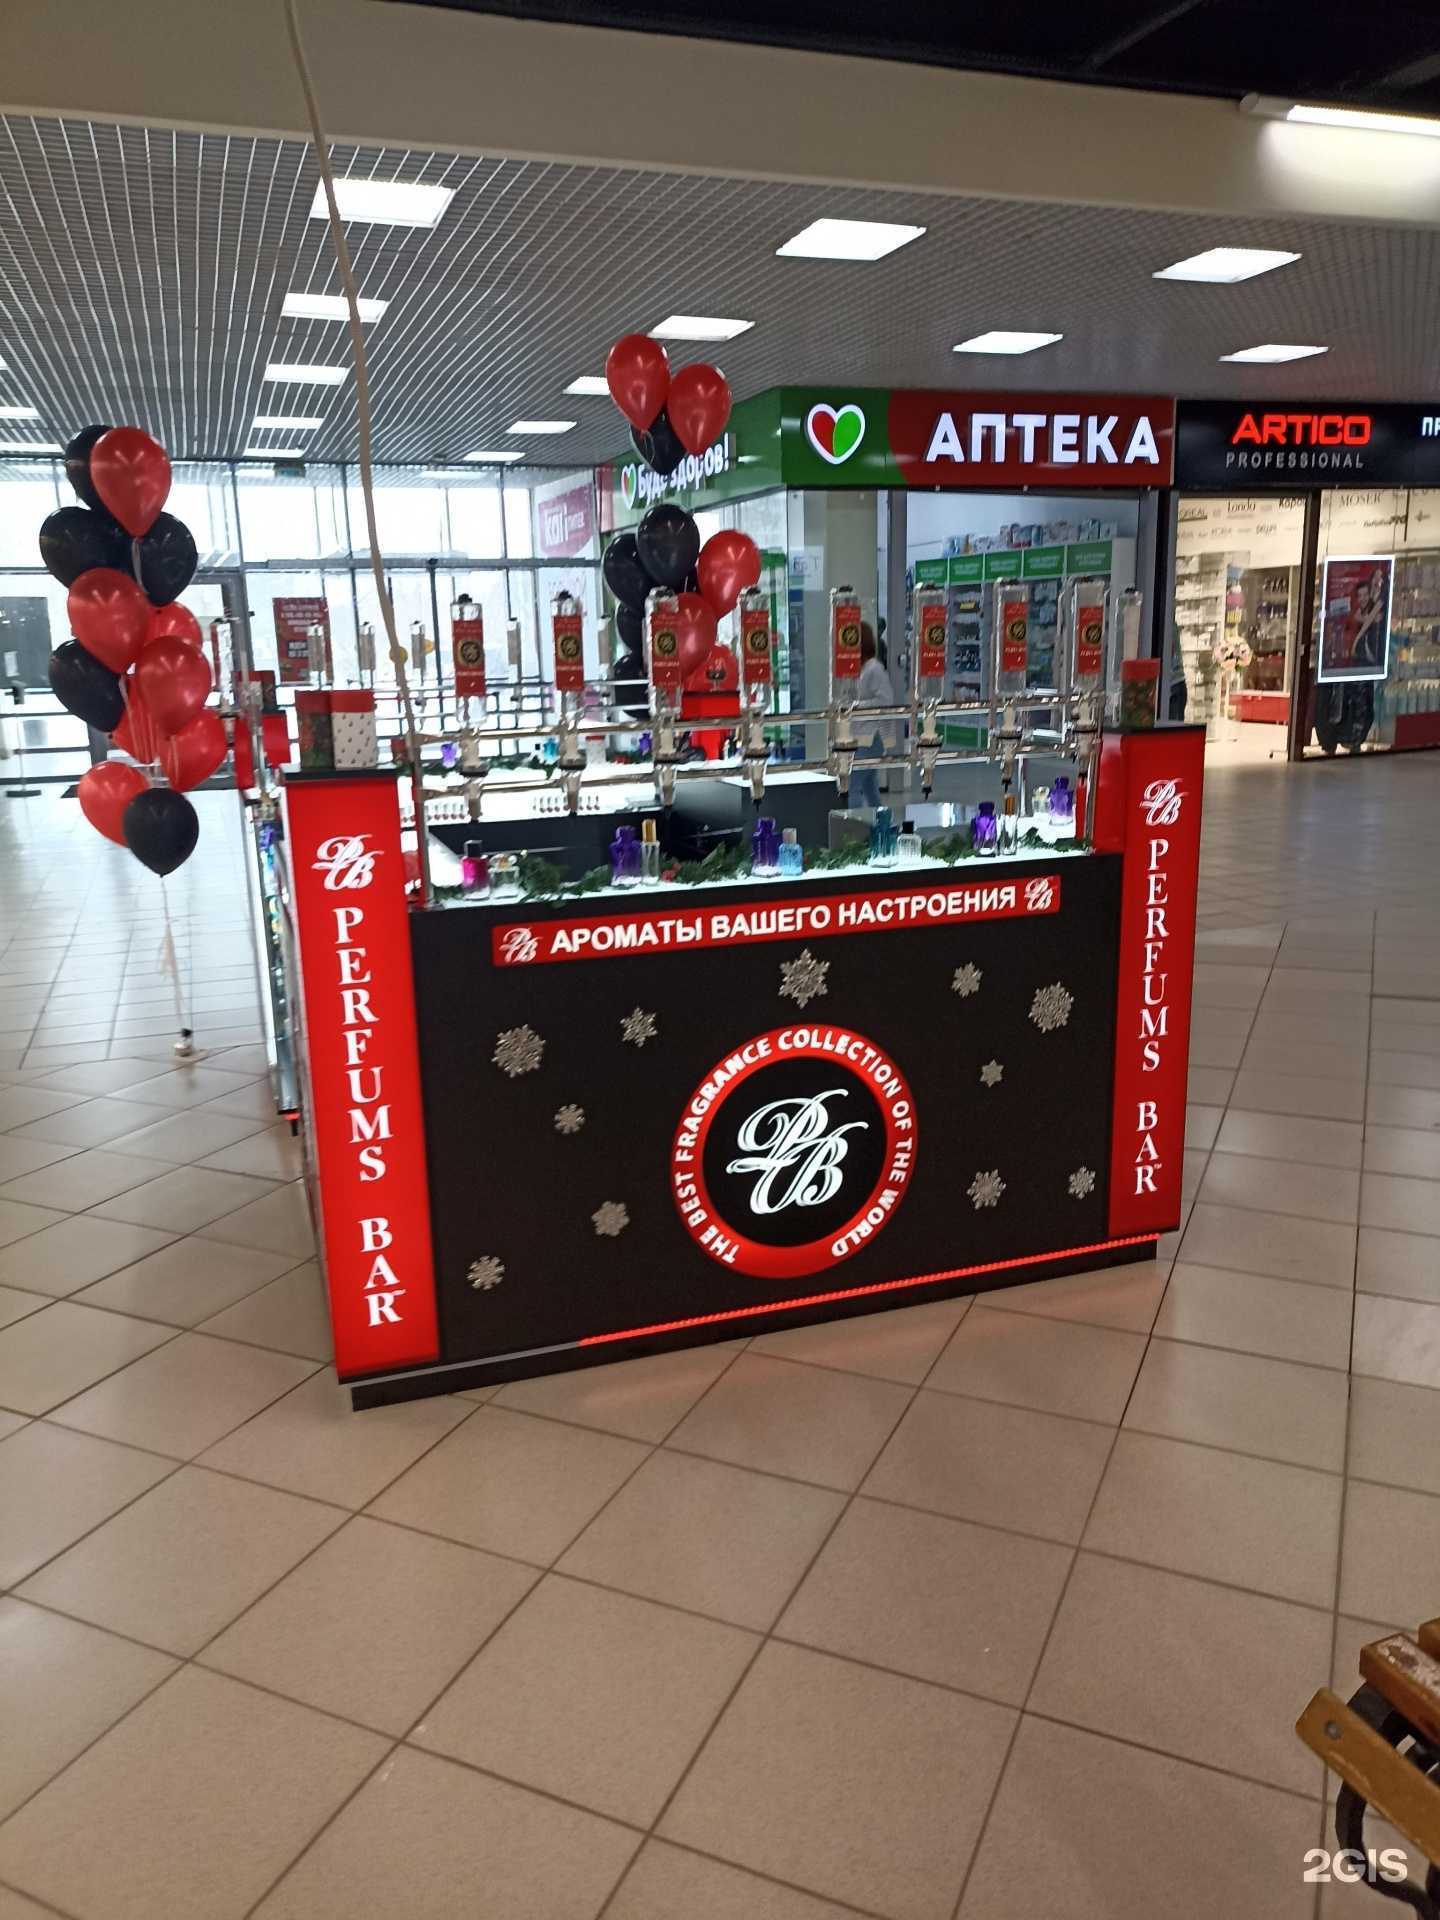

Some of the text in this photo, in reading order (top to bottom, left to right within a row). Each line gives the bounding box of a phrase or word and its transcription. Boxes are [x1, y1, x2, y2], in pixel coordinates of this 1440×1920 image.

[926, 412, 1160, 465] АПТЕКА
[1225, 452, 1365, 469] PROFESSIONAL
[1232, 413, 1372, 445] ARTICO
[550, 886, 1016, 955] АРОМАТЫ ВАШЕГО НАСТРОЕНИЯ
[1138, 838, 1169, 1073] PERFUMS
[333, 907, 393, 1183] PERFUMS
[675, 1028, 912, 1264] THE BEST FRAGRANCE COLLECTION OF THE WORLD
